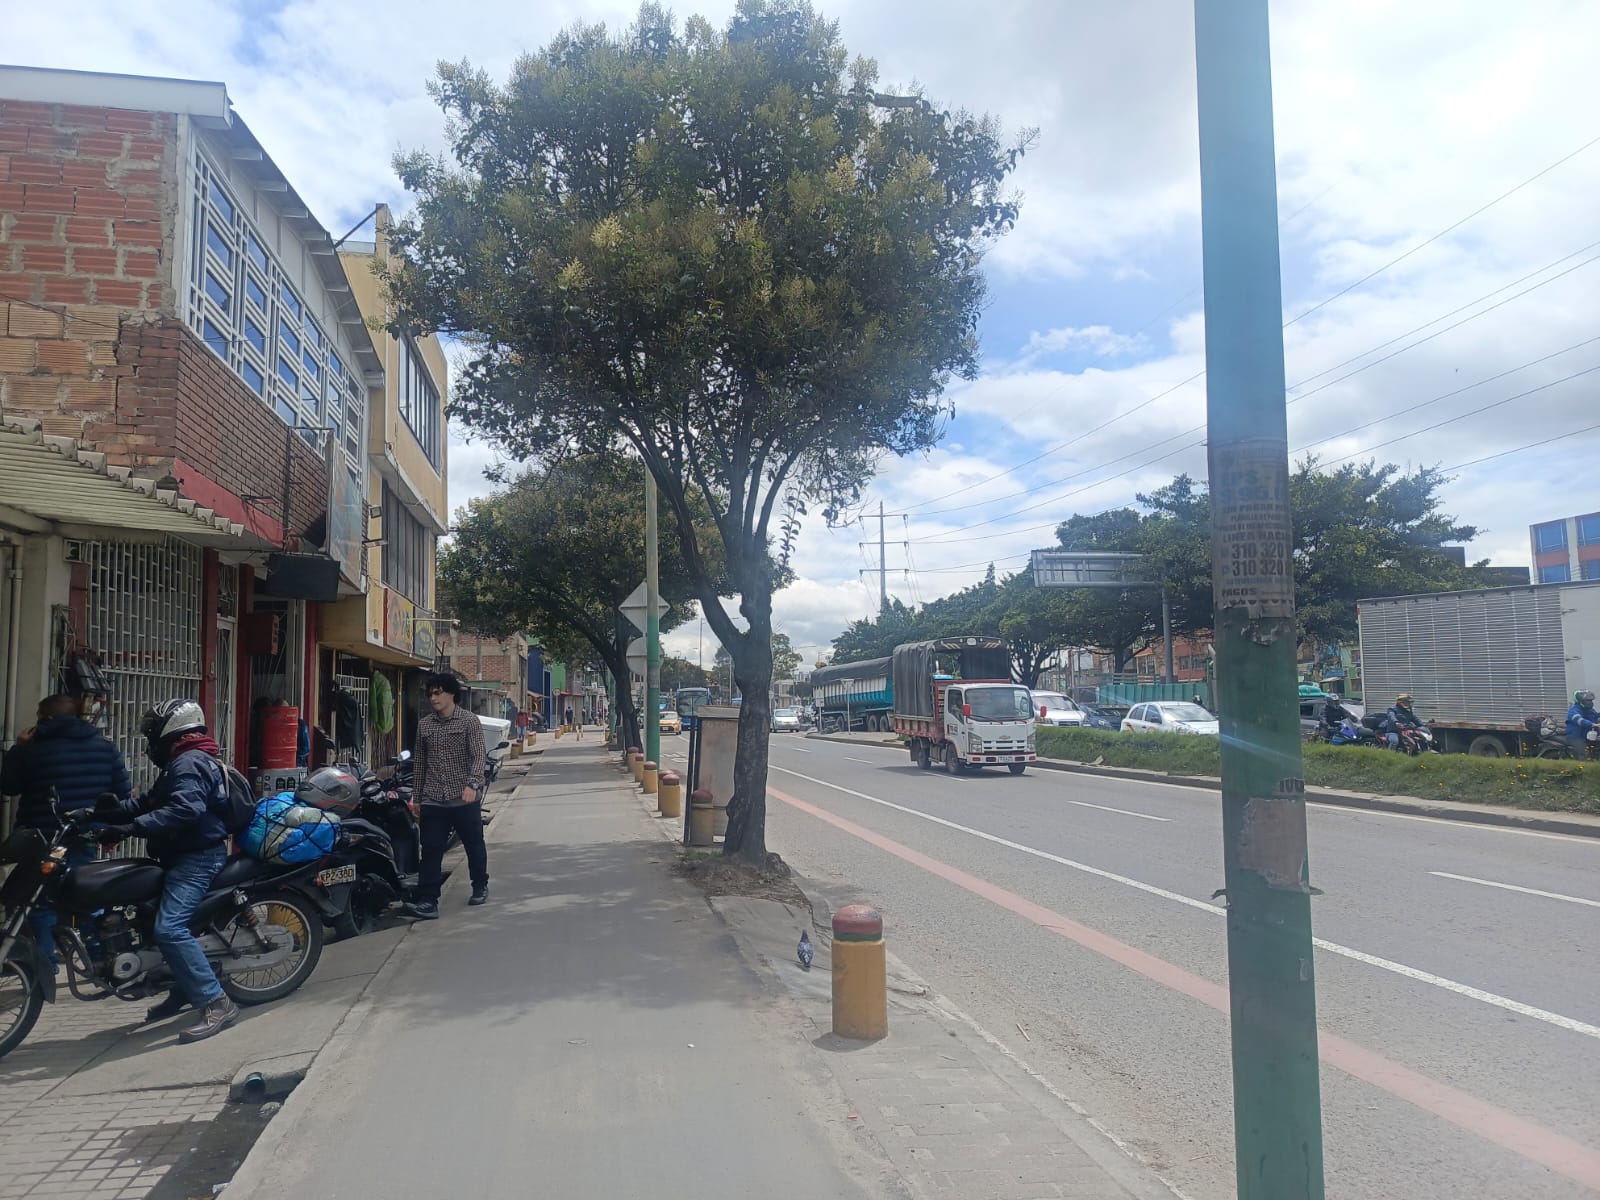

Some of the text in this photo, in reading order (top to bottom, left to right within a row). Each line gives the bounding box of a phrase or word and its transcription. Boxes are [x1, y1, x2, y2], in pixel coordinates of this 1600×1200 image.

[1232, 543, 1257, 559] 310
[1260, 542, 1284, 558] 320
[1232, 560, 1257, 576] 310
[1260, 560, 1284, 576] 320
